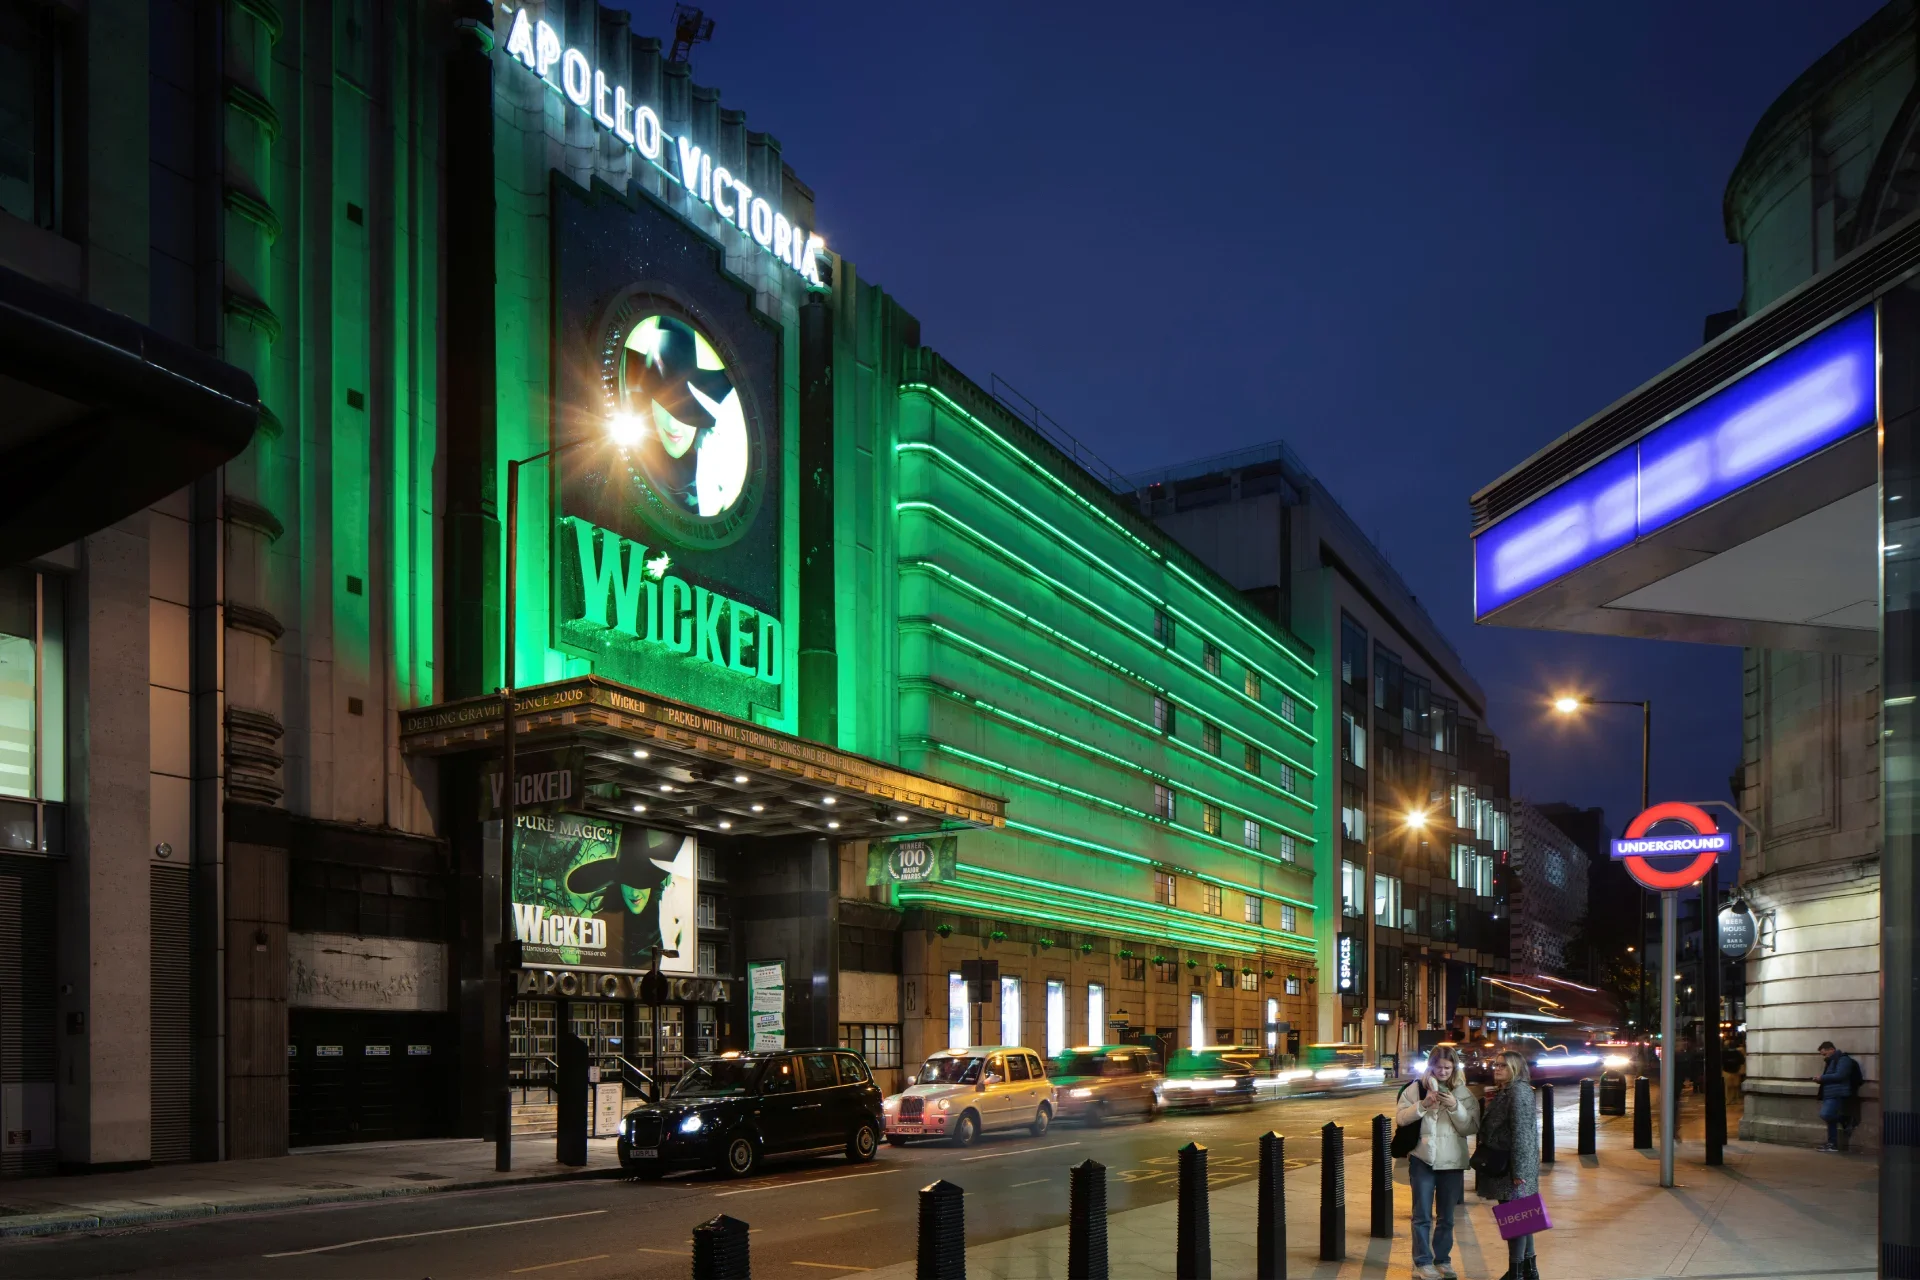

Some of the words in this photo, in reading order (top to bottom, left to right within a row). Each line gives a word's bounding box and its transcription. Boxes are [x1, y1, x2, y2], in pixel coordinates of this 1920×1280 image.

[504, 8, 660, 160] APOLLO
[674, 135, 820, 285] VICTORIA
[408, 712, 456, 731] DEFYING
[459, 703, 505, 721] GRAVIT
[514, 694, 549, 712] SINCE
[554, 689, 583, 704] 2006
[702, 718, 722, 734] WITH
[724, 723, 740, 741] WIT,
[741, 729, 777, 749] STORMING
[779, 741, 801, 756] SONGS
[803, 747, 815, 761] AND
[817, 751, 850, 770] BEAUTIFUL
[898, 850, 926, 867] 100
[1617, 837, 1724, 853] UNDERGROUND
[518, 969, 619, 998] APOLLO
[627, 975, 729, 1002] VTORIA
